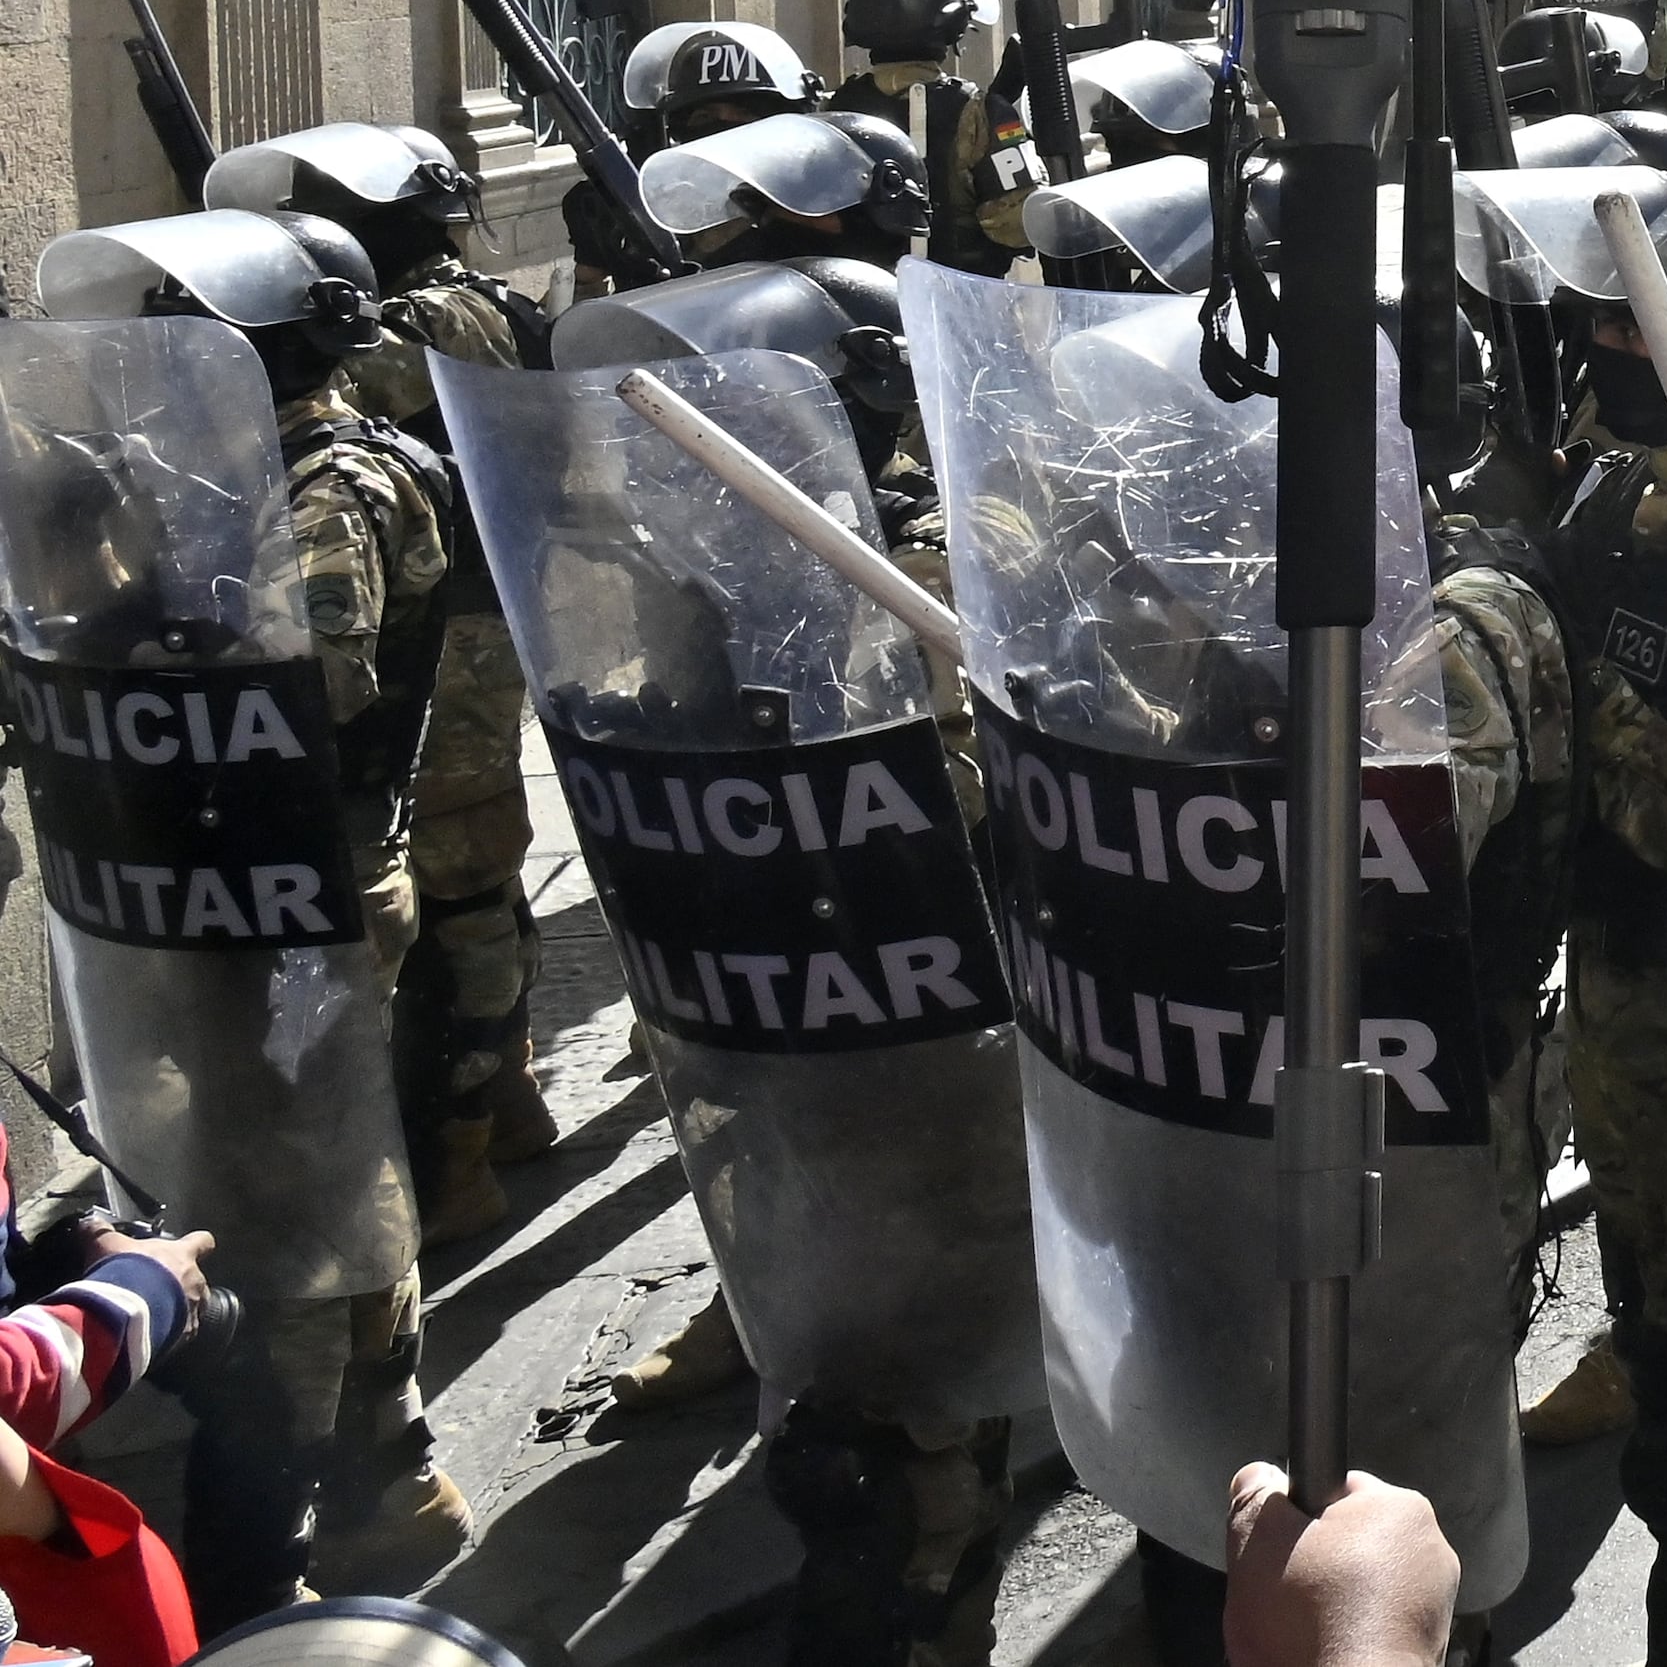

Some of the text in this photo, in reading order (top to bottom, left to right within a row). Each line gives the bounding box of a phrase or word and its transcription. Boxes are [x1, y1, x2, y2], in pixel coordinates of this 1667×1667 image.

[698, 44, 761, 85] PM
[1616, 625, 1657, 668] 126
[13, 669, 307, 765] OLICIA
[567, 757, 933, 857] OLICIA
[48, 839, 335, 938] ILITAR
[625, 932, 981, 1030] ILITAR
